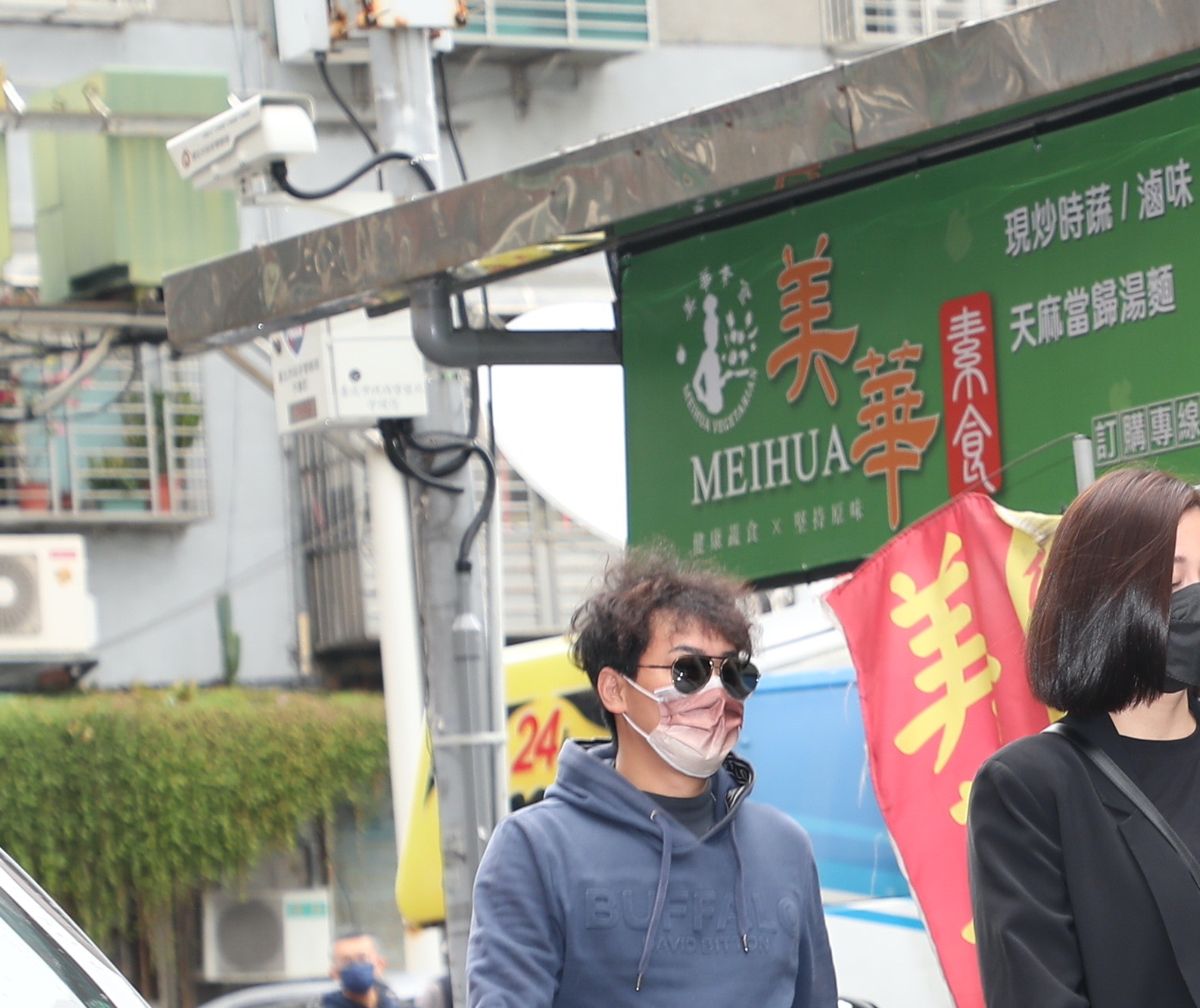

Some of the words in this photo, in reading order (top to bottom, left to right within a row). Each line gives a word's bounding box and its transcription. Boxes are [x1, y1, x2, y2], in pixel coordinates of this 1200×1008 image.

[1004, 182, 1114, 257] 現炒時蔬
[1136, 157, 1194, 220] 滷味
[1009, 264, 1176, 352] 天麻當歸湯麵
[766, 233, 940, 530] 美華
[947, 306, 997, 493] 素食
[691, 424, 850, 506] MEIHUA
[512, 708, 561, 773] 24
[584, 886, 802, 937] BUFFALO
[652, 935, 696, 954] AVID
